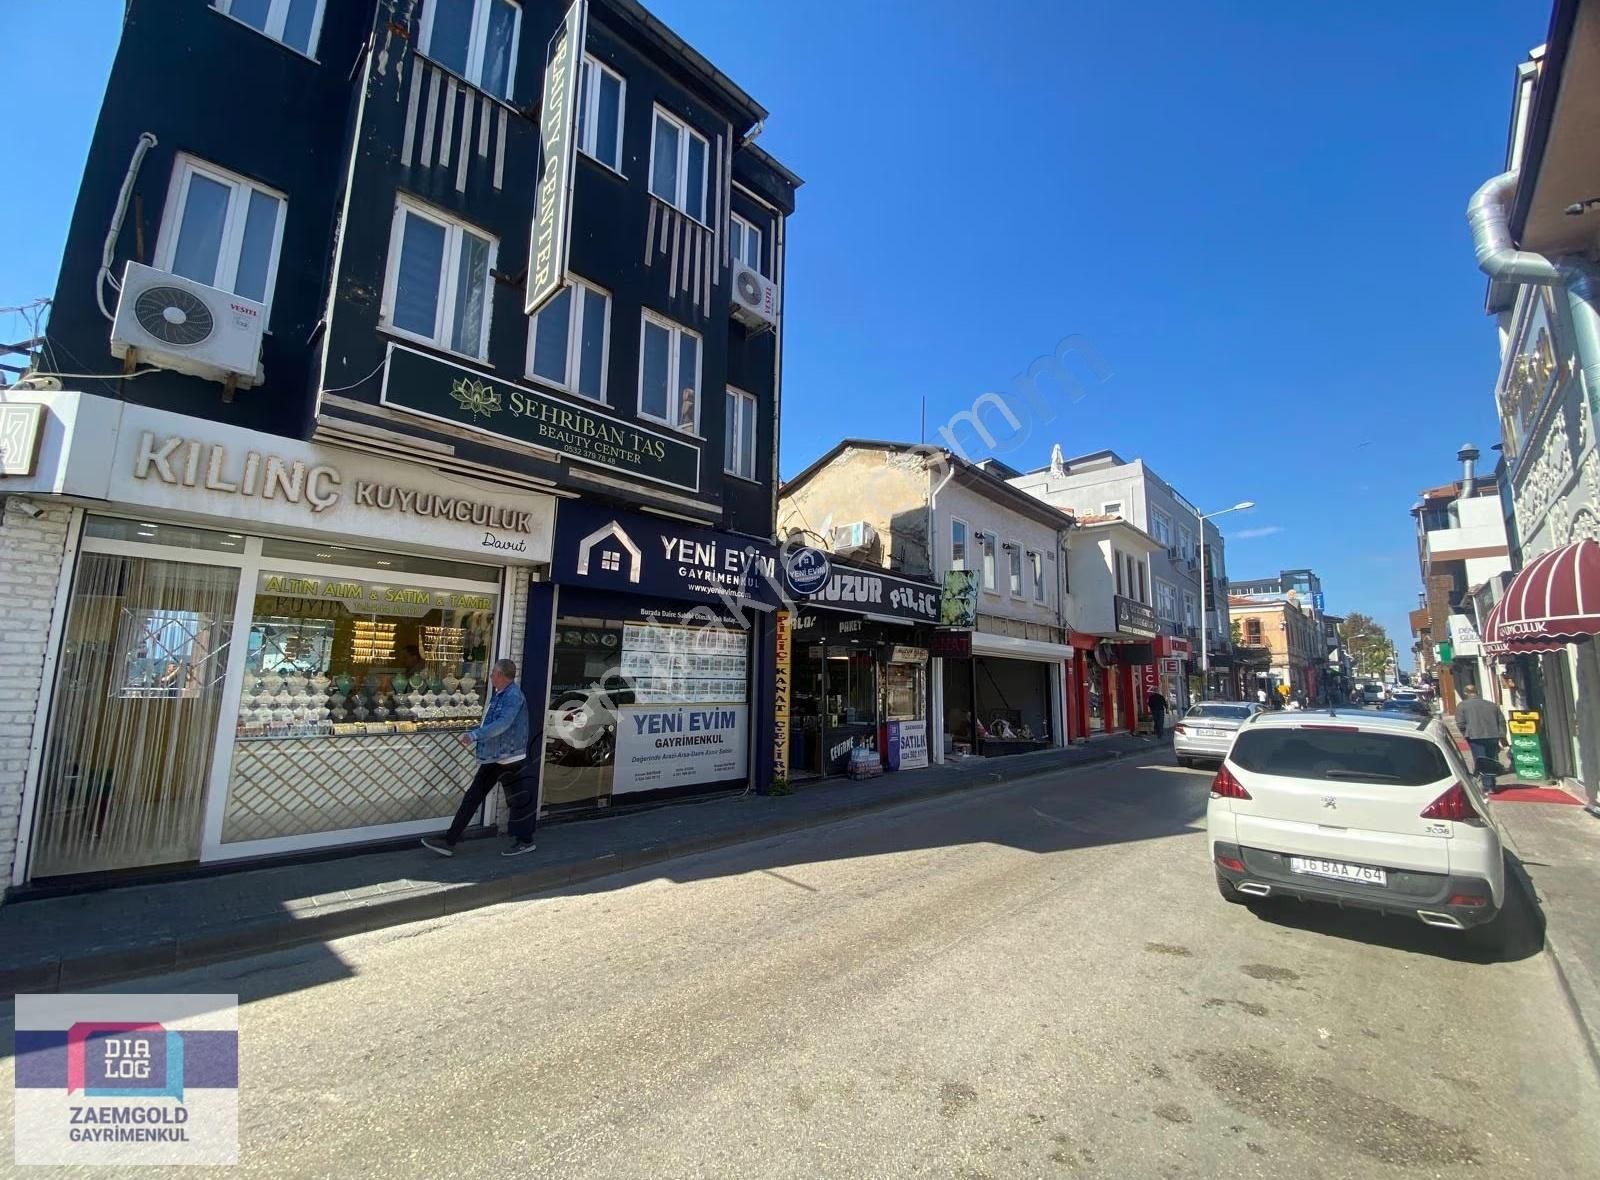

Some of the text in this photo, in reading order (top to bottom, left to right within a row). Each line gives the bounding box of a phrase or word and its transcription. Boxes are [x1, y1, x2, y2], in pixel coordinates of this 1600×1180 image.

[534, 155, 558, 293] CENTER
[508, 392, 667, 462] ŞEHRİBAN TAŞ
[538, 423, 642, 465] BEAUTY CENTER
[563, 444, 582, 456] 0532
[134, 431, 533, 534] KILINÇ KUYUMCULUK
[482, 532, 528, 553] Davut
[661, 535, 775, 578] YENİ EVİM
[267, 576, 319, 594] ALTIN
[322, 582, 363, 599] ALIM
[385, 589, 431, 606] SATIM
[679, 567, 759, 589] GAYRİMENKUL
[889, 587, 937, 618] PİLİÇ
[775, 668, 787, 712] KANAT
[633, 707, 736, 735] YENİ EVİM
[655, 734, 724, 748] GAYRİMENKUL
[1302, 859, 1317, 870] 16
[1321, 861, 1349, 876] BAA
[1354, 867, 1382, 881] 764
